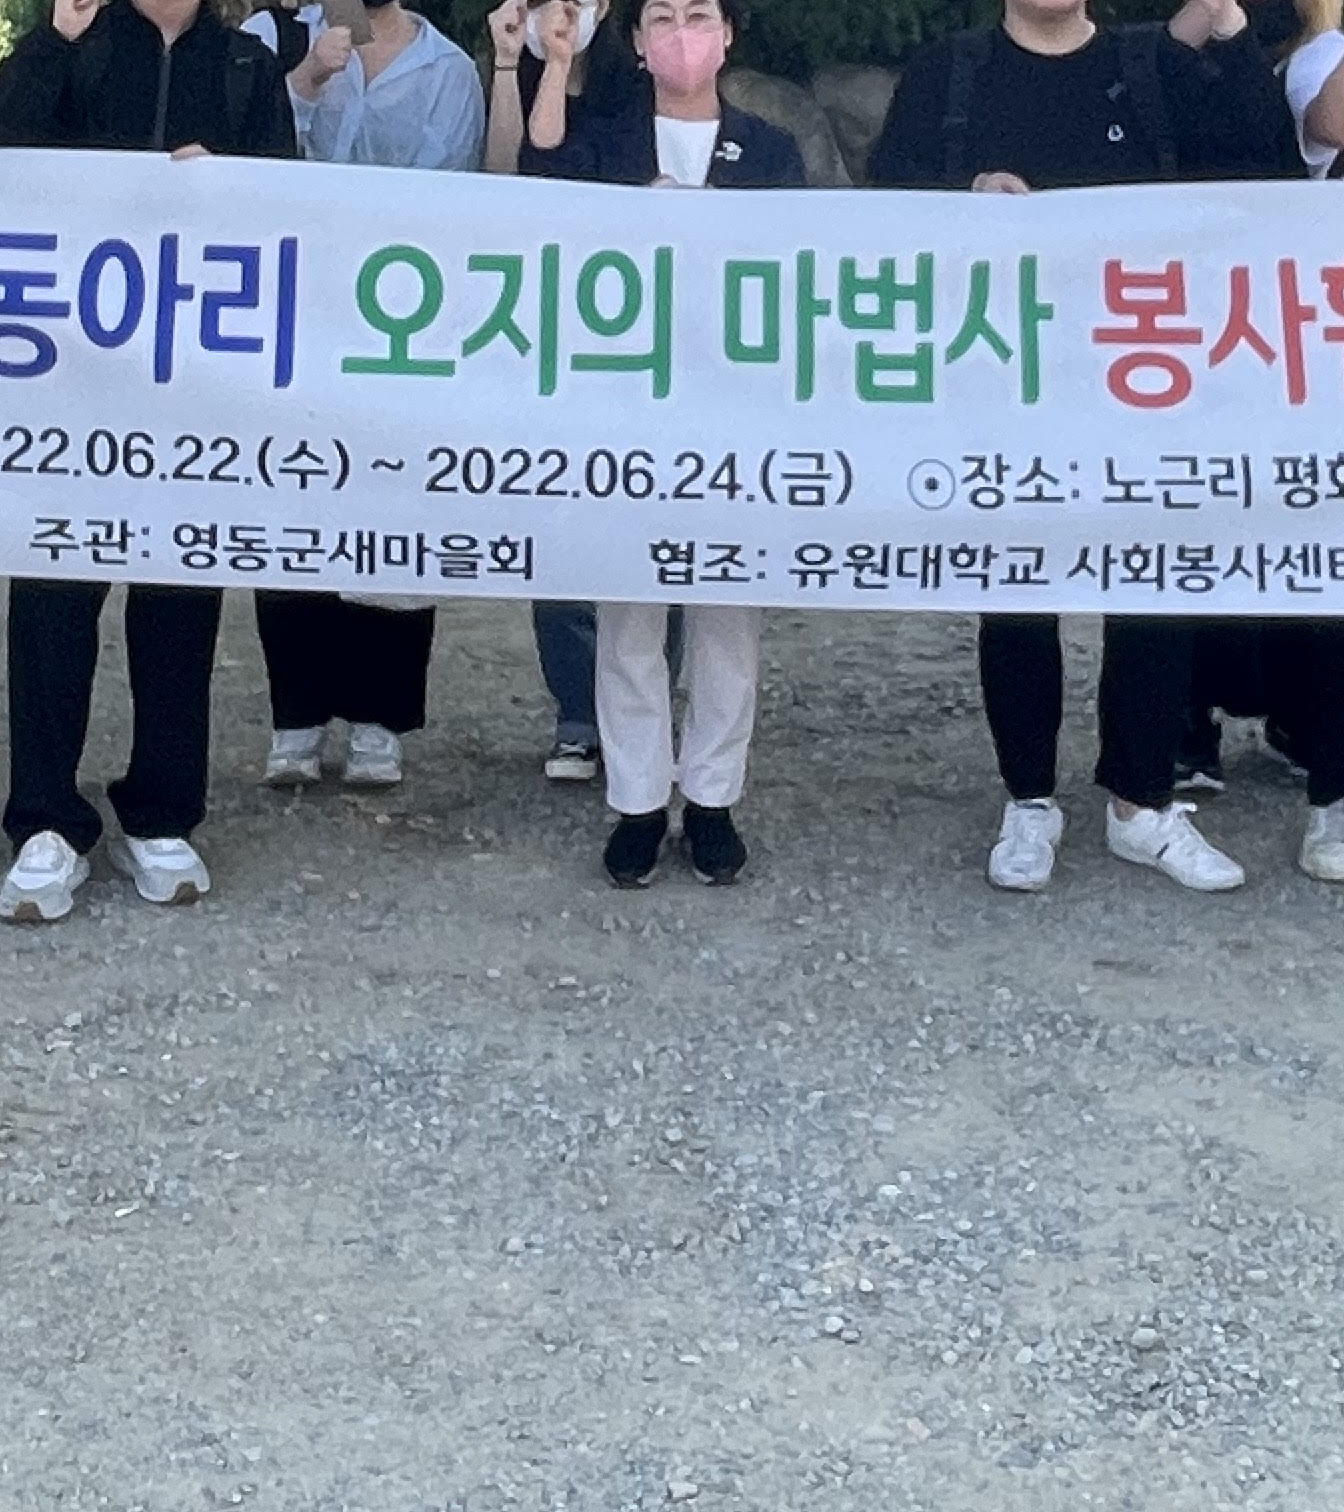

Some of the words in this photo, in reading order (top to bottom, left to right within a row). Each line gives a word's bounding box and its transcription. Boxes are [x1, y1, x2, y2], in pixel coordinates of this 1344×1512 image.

[341, 243, 673, 399] 오지의
[723, 249, 1054, 404] 마법사
[425, 445, 853, 508] 2022.06.24.(금)
[960, 452, 1081, 510] 장소:
[1102, 451, 1253, 510] 노근리
[28, 516, 151, 566] 주관:
[172, 521, 535, 582] 영동군새마을회
[648, 538, 767, 586] 협조:
[787, 541, 1051, 591] 유원대학교
